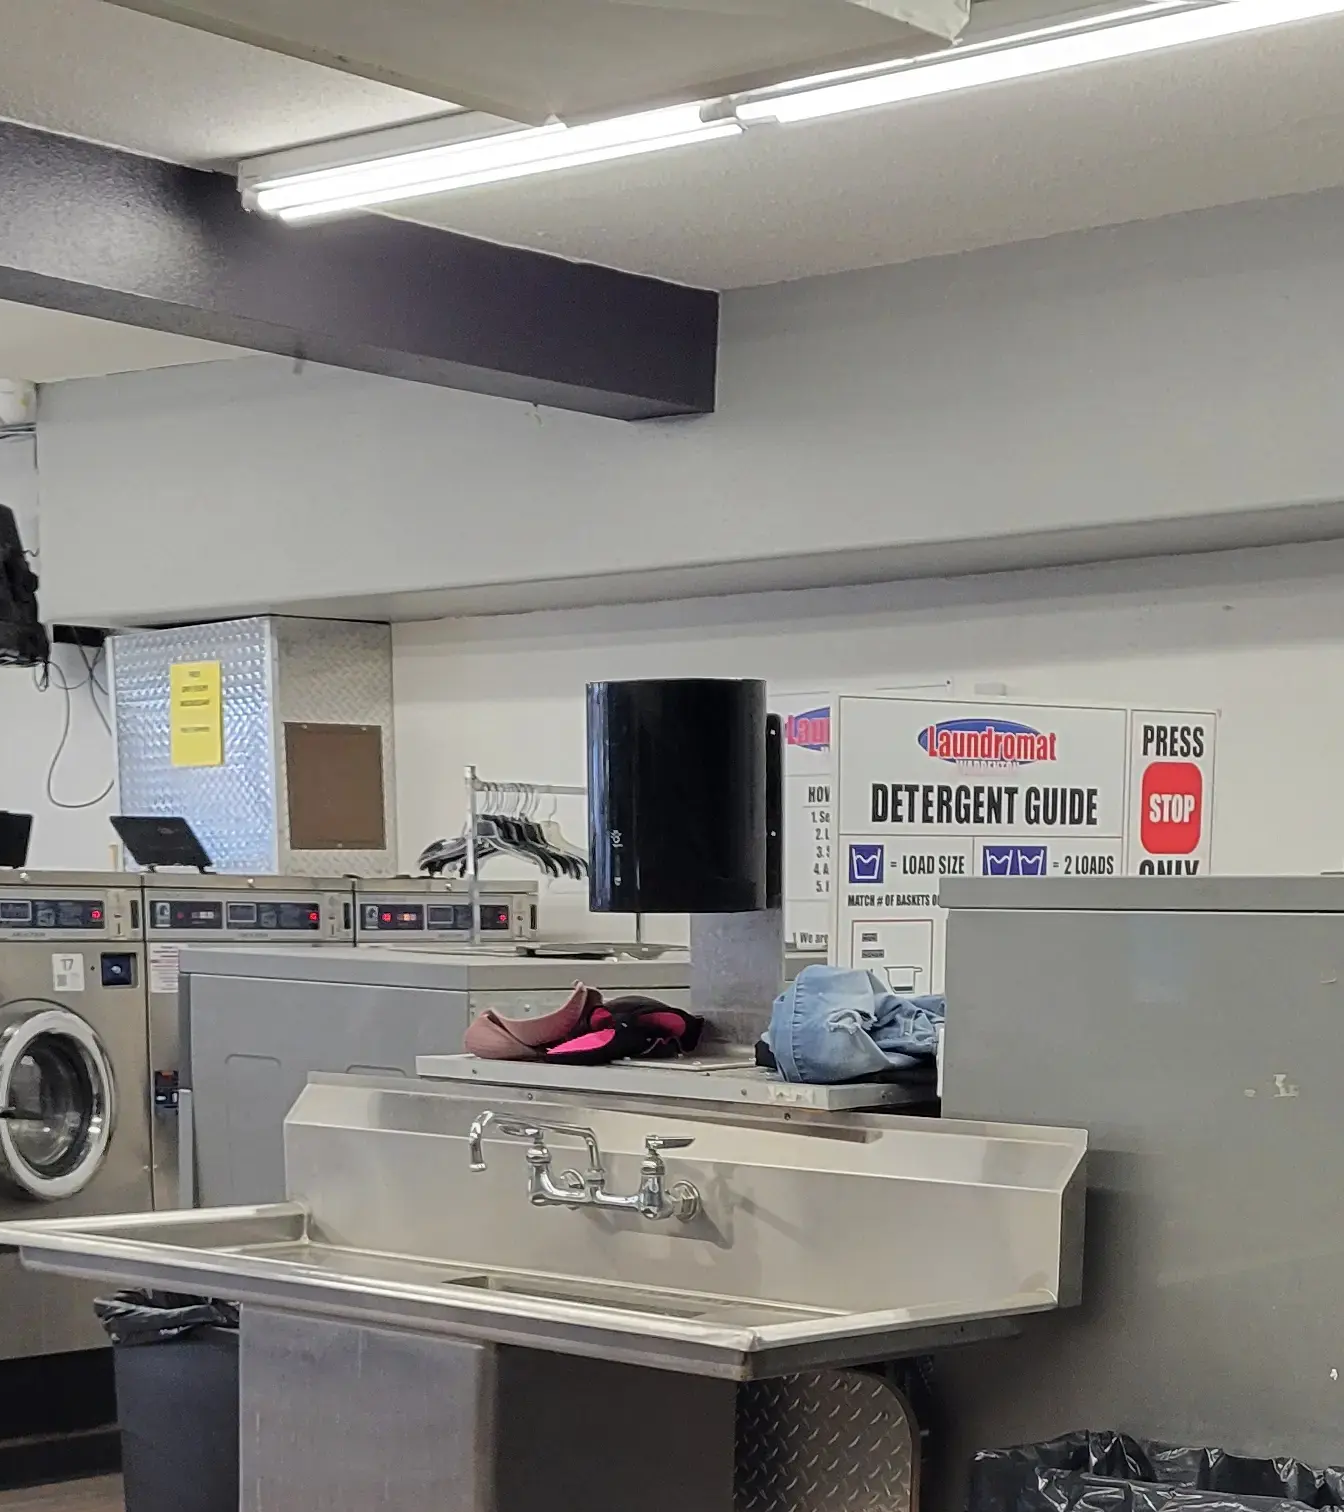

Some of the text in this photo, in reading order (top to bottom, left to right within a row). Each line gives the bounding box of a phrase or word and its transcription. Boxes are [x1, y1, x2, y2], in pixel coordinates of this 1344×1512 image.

[927, 724, 1057, 761] Laundromat
[1142, 724, 1205, 758] PRESS
[871, 783, 1098, 826] DETERGENT GUIDE
[1149, 794, 1195, 823] STOP
[902, 855, 935, 875] LOAD
[938, 855, 966, 875] SIZE
[1064, 855, 1073, 875] 2
[1075, 855, 1115, 875] LOADS
[847, 894, 875, 907] MATCH
[885, 894, 895, 906] OF
[896, 894, 930, 906] BASKETS
